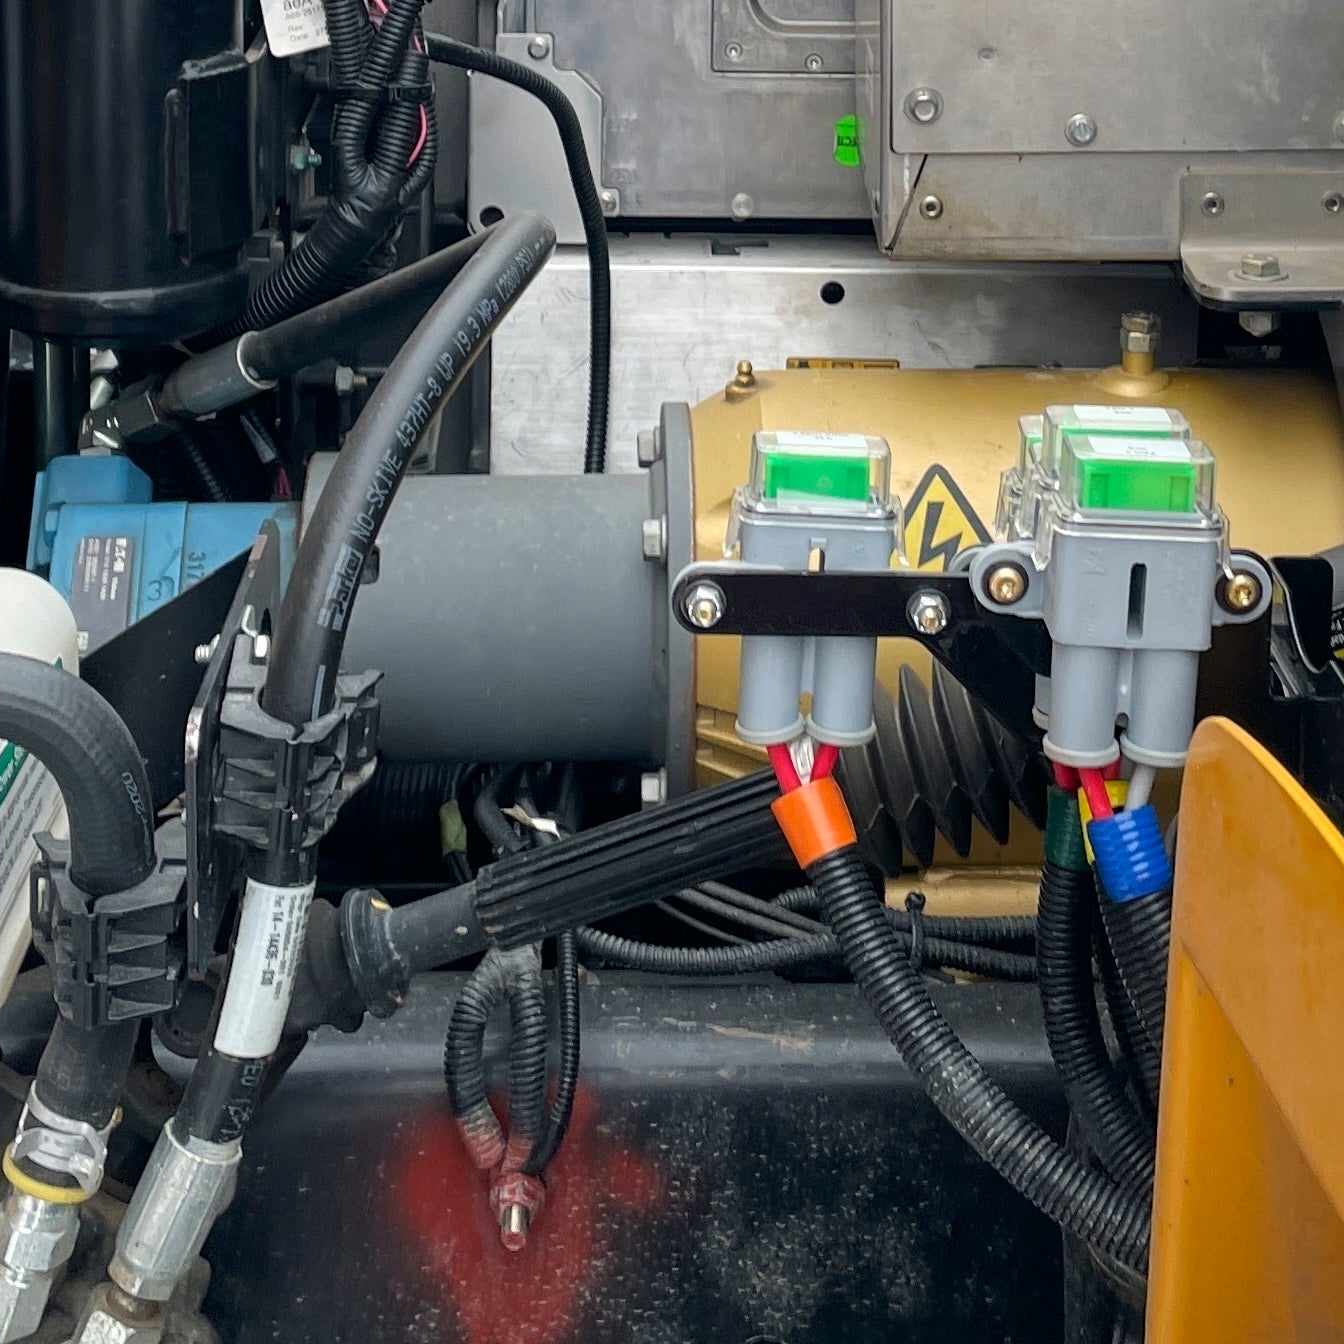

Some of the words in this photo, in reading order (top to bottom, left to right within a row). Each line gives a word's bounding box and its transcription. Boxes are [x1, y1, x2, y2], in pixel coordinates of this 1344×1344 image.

[324, 546, 364, 623] Parker
[350, 448, 403, 544] NO-SKIVE
[395, 377, 443, 448] 437HT-8
[453, 317, 482, 358] 19.3
[477, 297, 500, 327] MPa
